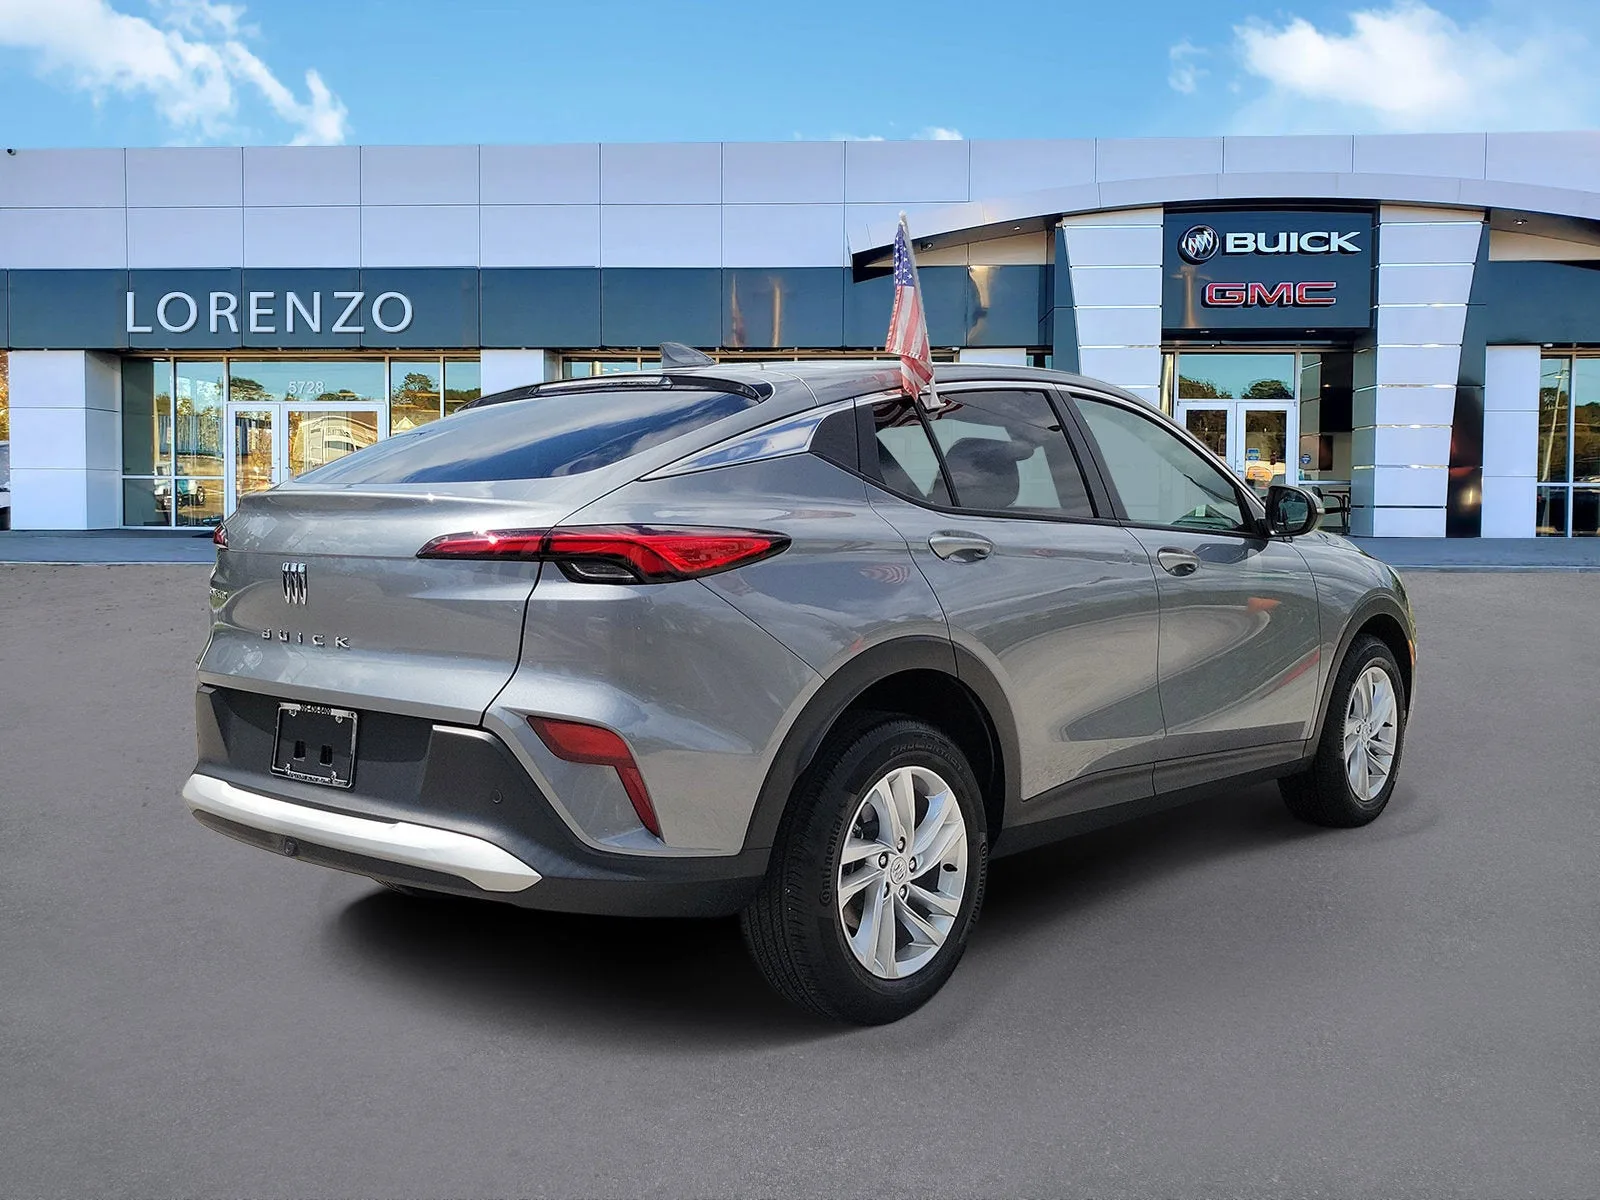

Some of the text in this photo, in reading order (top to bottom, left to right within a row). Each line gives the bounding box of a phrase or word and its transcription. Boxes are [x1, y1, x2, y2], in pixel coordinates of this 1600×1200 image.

[1225, 231, 1362, 253] BUICK
[1205, 281, 1337, 305] GMC
[126, 291, 413, 333] LORENZO
[288, 380, 325, 394] 5728
[261, 627, 350, 649] BUICK
